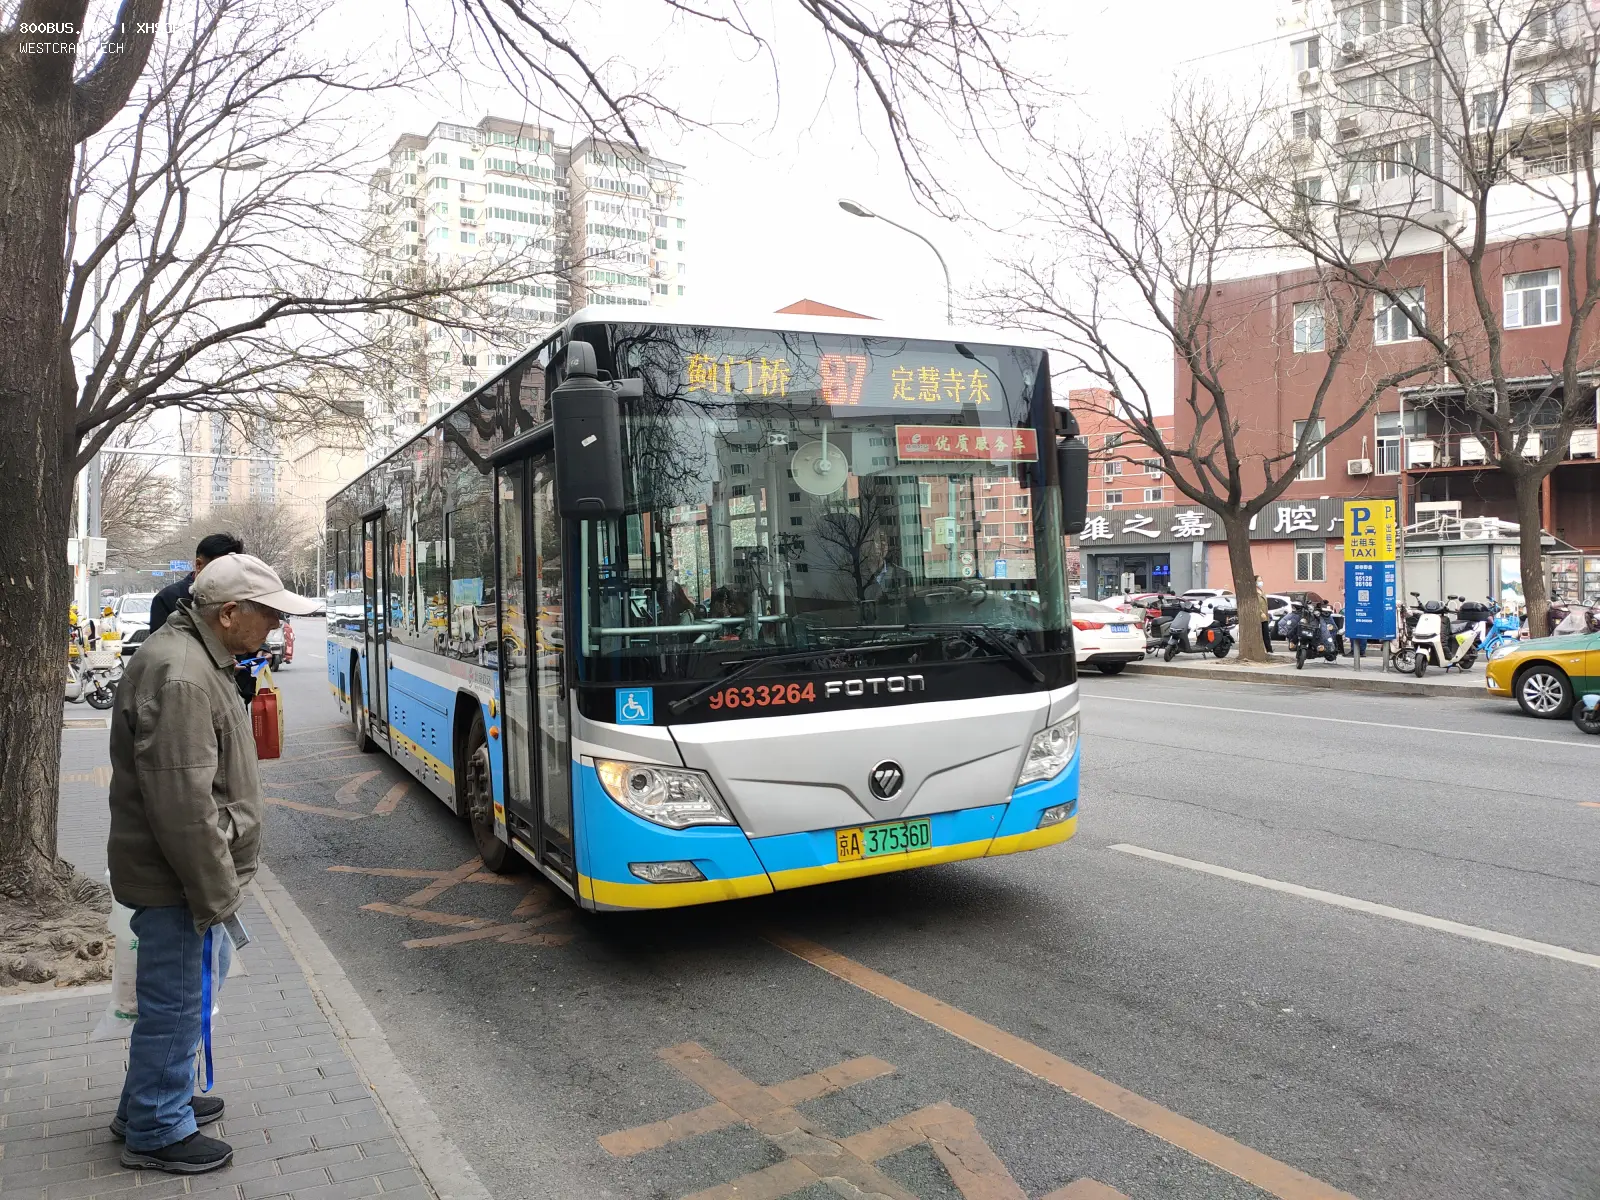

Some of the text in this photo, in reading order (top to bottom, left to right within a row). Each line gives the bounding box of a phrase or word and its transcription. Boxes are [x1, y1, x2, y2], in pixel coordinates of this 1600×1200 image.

[819, 354, 868, 405] 87
[892, 365, 990, 404] 定慧寺东
[934, 434, 1026, 454] 优质服务车
[1079, 504, 1345, 541] 维之嘉腔
[1350, 507, 1371, 537] P
[1350, 538, 1376, 547] 出租车
[1351, 548, 1376, 558] TAXI
[709, 674, 925, 710] 9633264 FOTON
